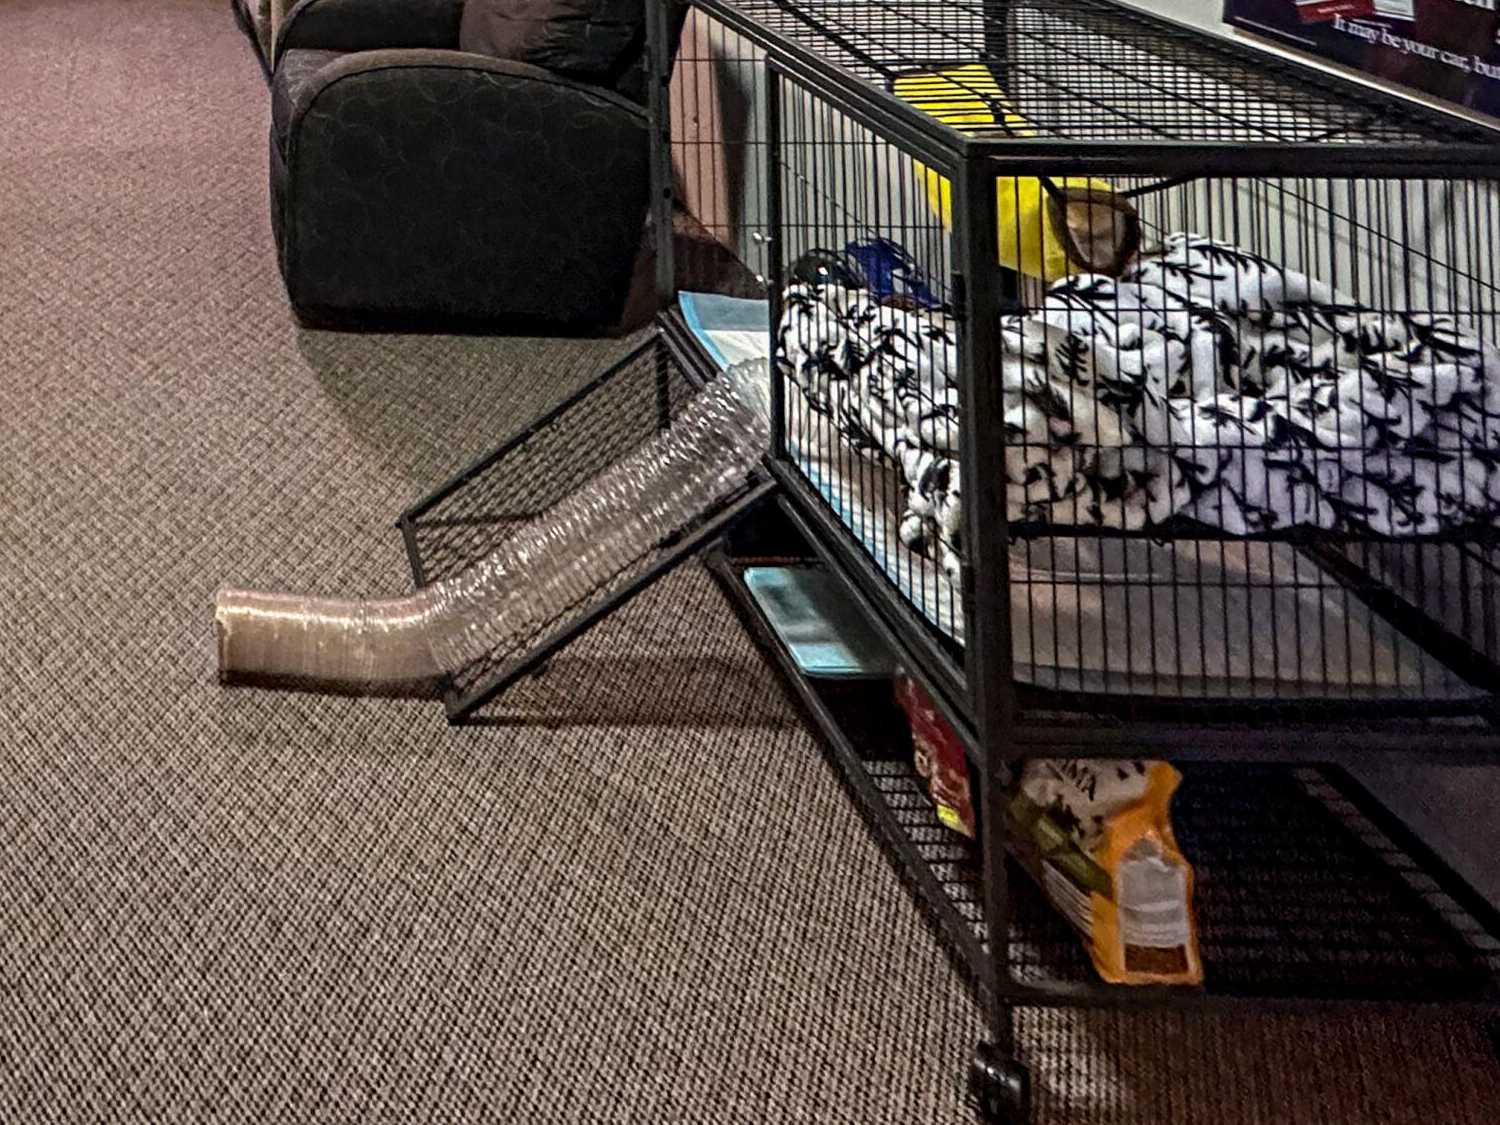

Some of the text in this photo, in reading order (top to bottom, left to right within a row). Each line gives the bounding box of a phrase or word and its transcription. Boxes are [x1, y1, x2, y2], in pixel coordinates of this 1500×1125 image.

[1331, 13, 1346, 31] It
[1347, 22, 1380, 44] may
[1381, 27, 1400, 48] be
[1400, 38, 1440, 59] your
